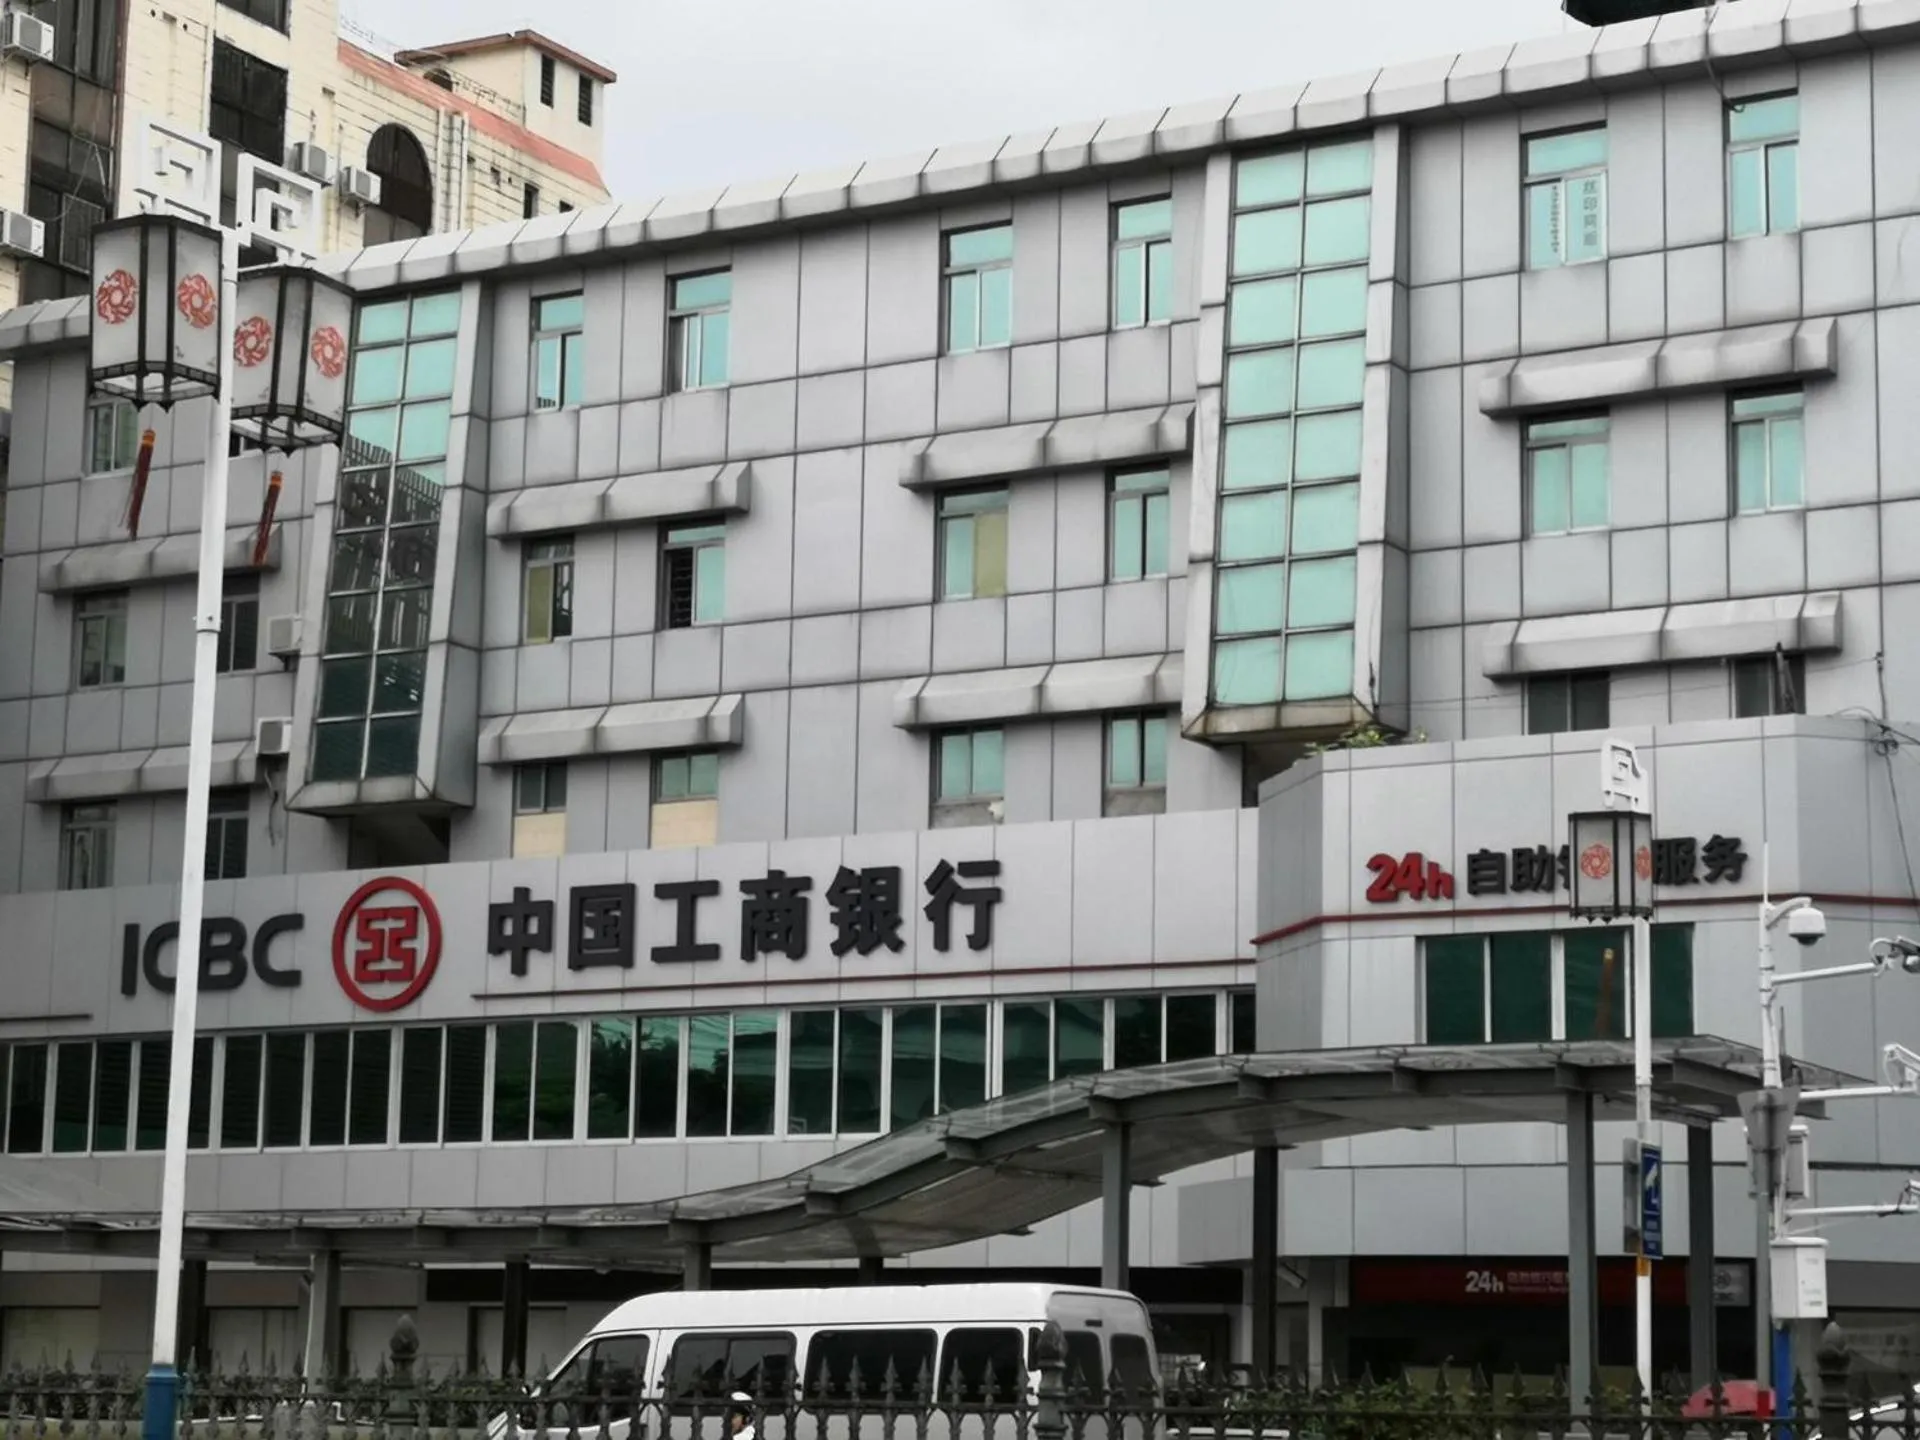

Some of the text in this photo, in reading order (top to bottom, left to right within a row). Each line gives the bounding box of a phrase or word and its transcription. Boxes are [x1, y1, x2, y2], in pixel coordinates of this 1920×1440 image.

[1365, 833, 1748, 902] 24h 自助服务
[121, 913, 305, 996] ICBC
[487, 859, 1003, 976] 中国工商银行
[1465, 1270, 1504, 1293] 24h
